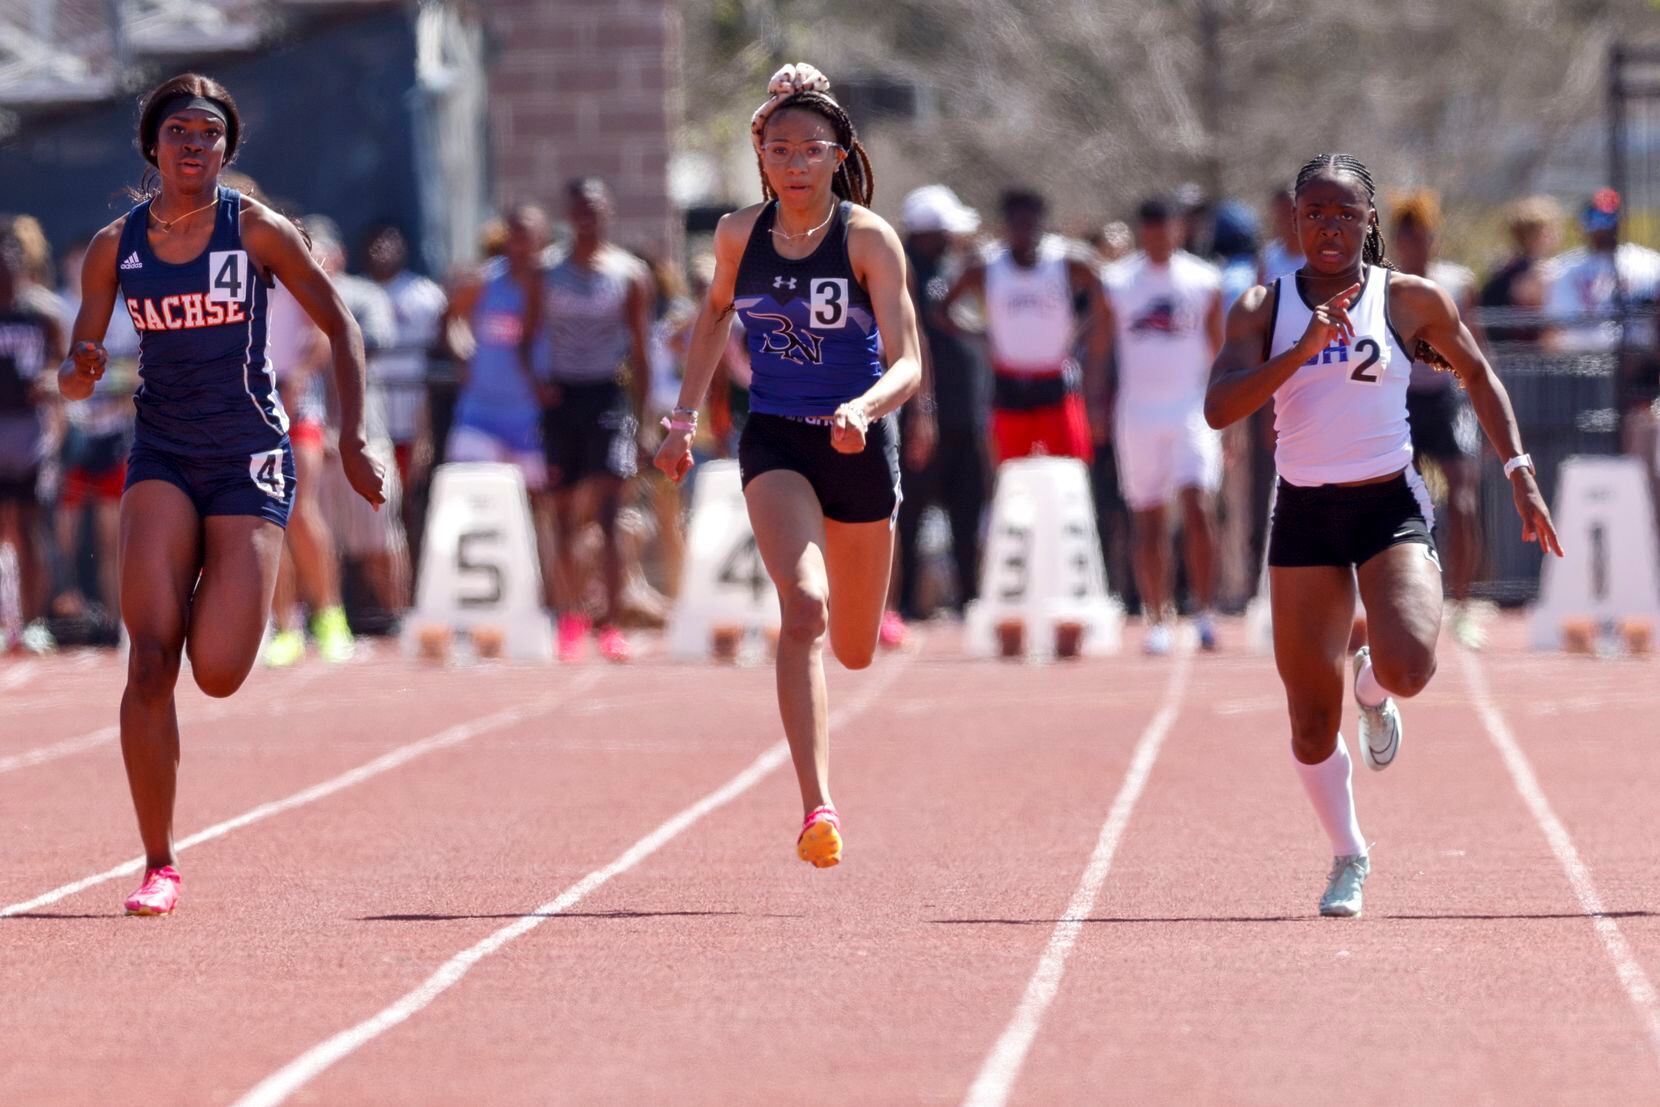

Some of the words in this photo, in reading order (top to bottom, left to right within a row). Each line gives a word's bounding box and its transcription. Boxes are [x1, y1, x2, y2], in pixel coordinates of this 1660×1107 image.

[120, 262, 143, 270] adidas
[214, 254, 242, 298] 4
[128, 292, 246, 331] SACHSE
[815, 281, 842, 325] 3
[1350, 338, 1381, 382] 2
[256, 453, 280, 493] 4
[456, 529, 504, 604] 5
[718, 533, 769, 603] 4
[1588, 521, 1610, 600] 1
